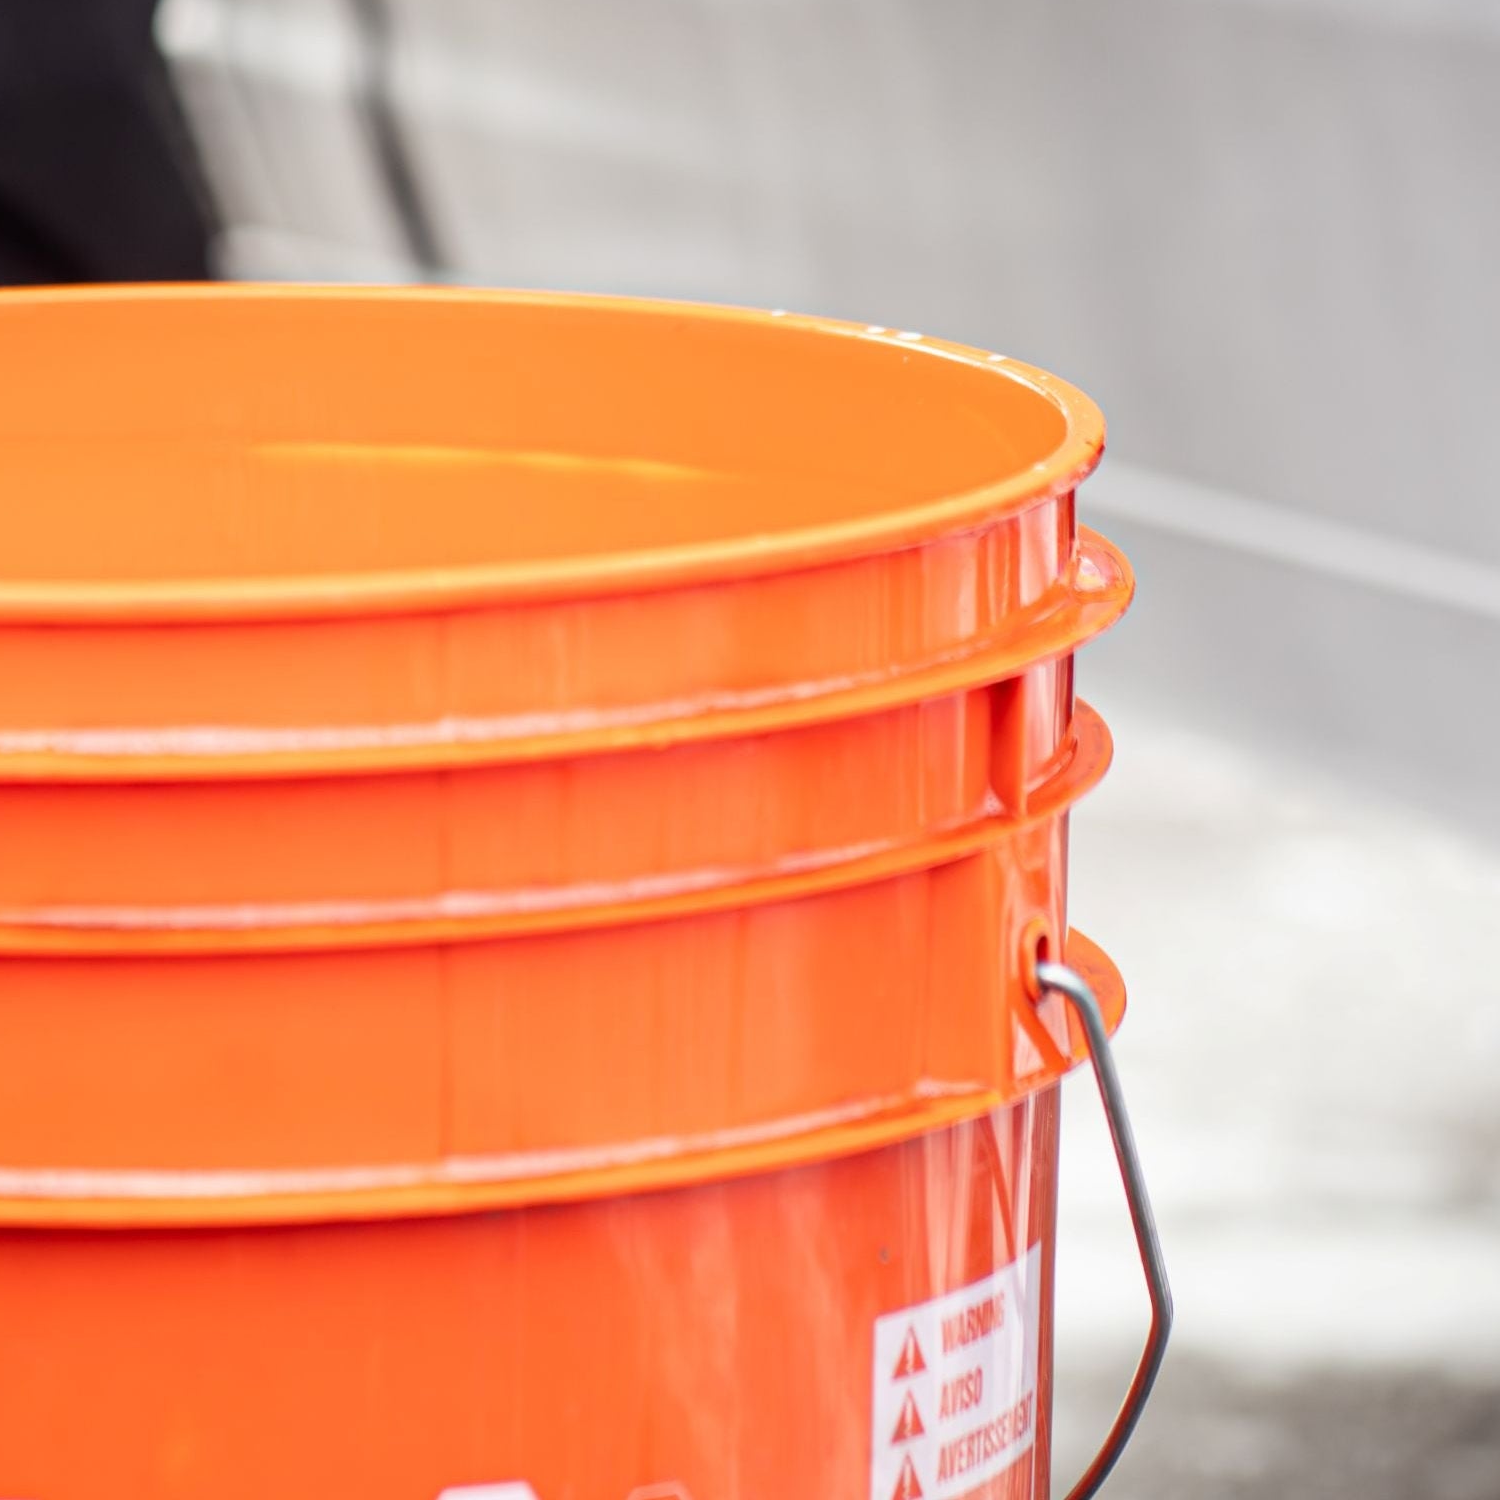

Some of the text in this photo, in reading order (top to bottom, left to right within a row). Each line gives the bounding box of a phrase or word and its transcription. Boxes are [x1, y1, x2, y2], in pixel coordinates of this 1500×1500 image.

[941, 1291, 1005, 1354] WARNING
[938, 1365, 984, 1421] AVISO
[935, 1388, 1034, 1486] AVERTISSEMENT
